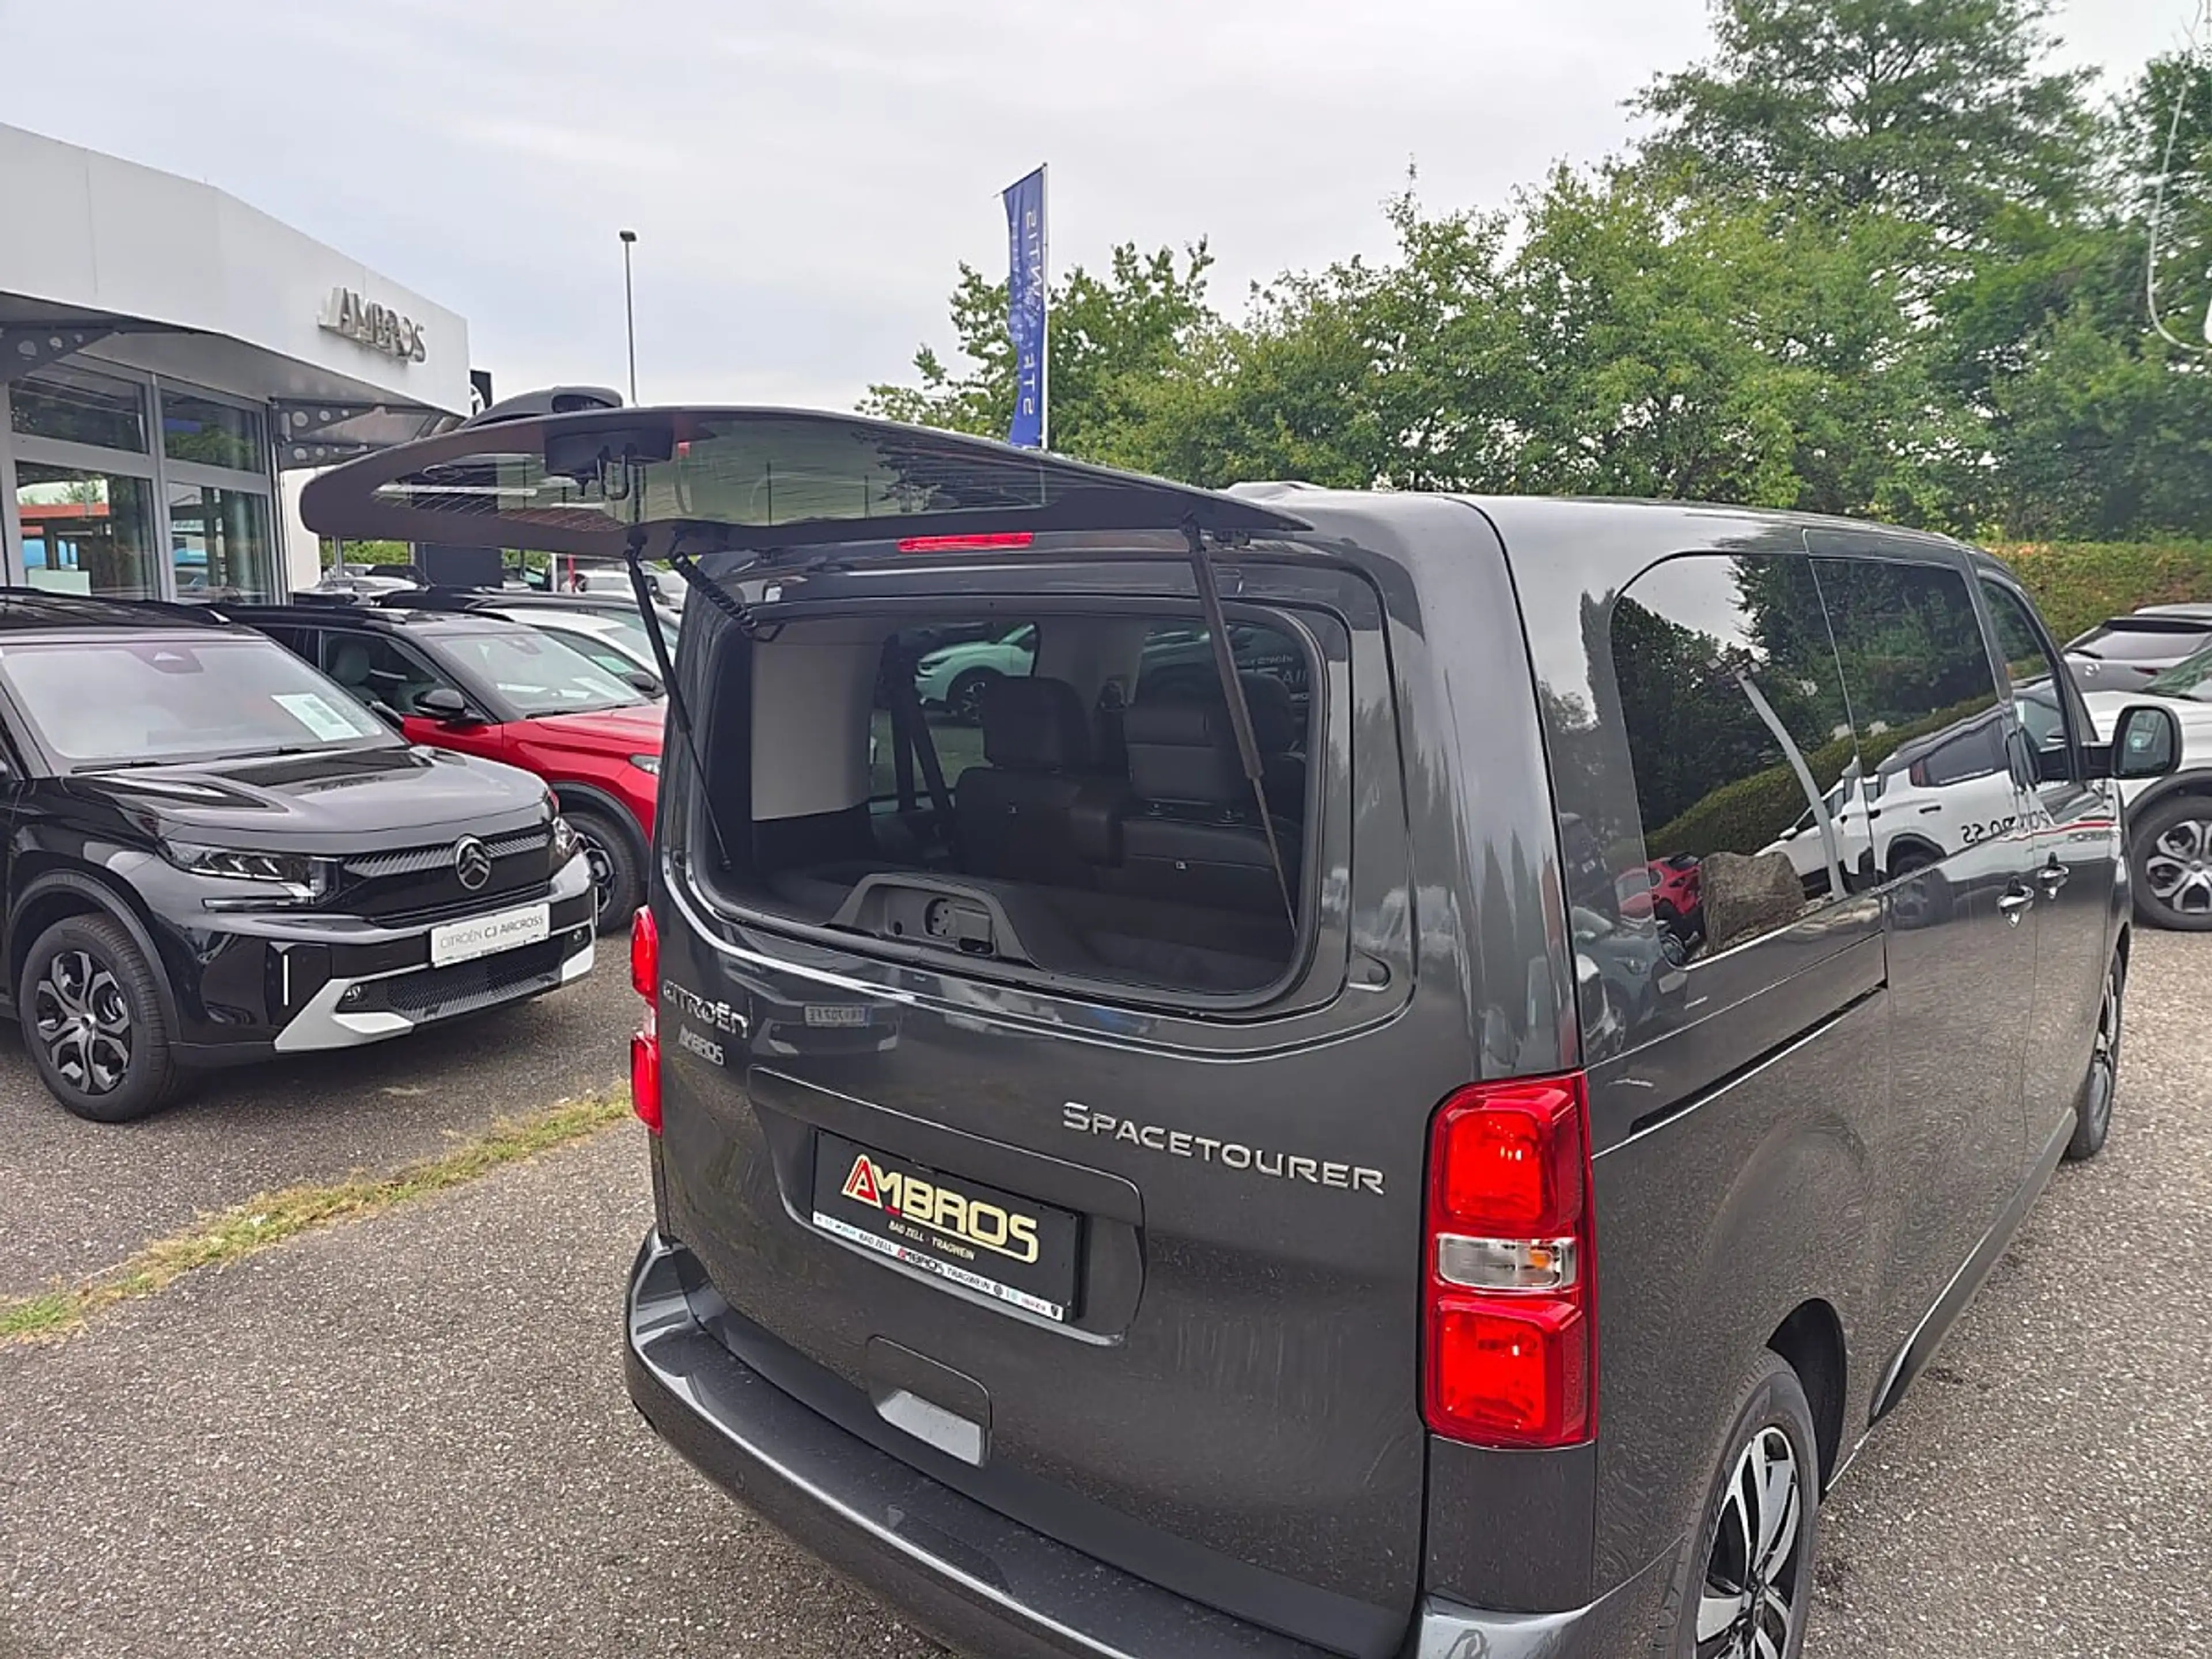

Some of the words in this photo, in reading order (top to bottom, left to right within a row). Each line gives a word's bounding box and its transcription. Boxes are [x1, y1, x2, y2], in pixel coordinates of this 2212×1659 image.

[319, 287, 427, 363] AMBROS
[499, 914, 543, 934] AIRCROSS
[1063, 1101, 1385, 1195] SPACETOURER
[841, 1153, 1039, 1264] AMBROS
[889, 1220, 904, 1234] BAD
[906, 1226, 924, 1242] ZELL
[932, 1237, 976, 1261] TRAGWEIN
